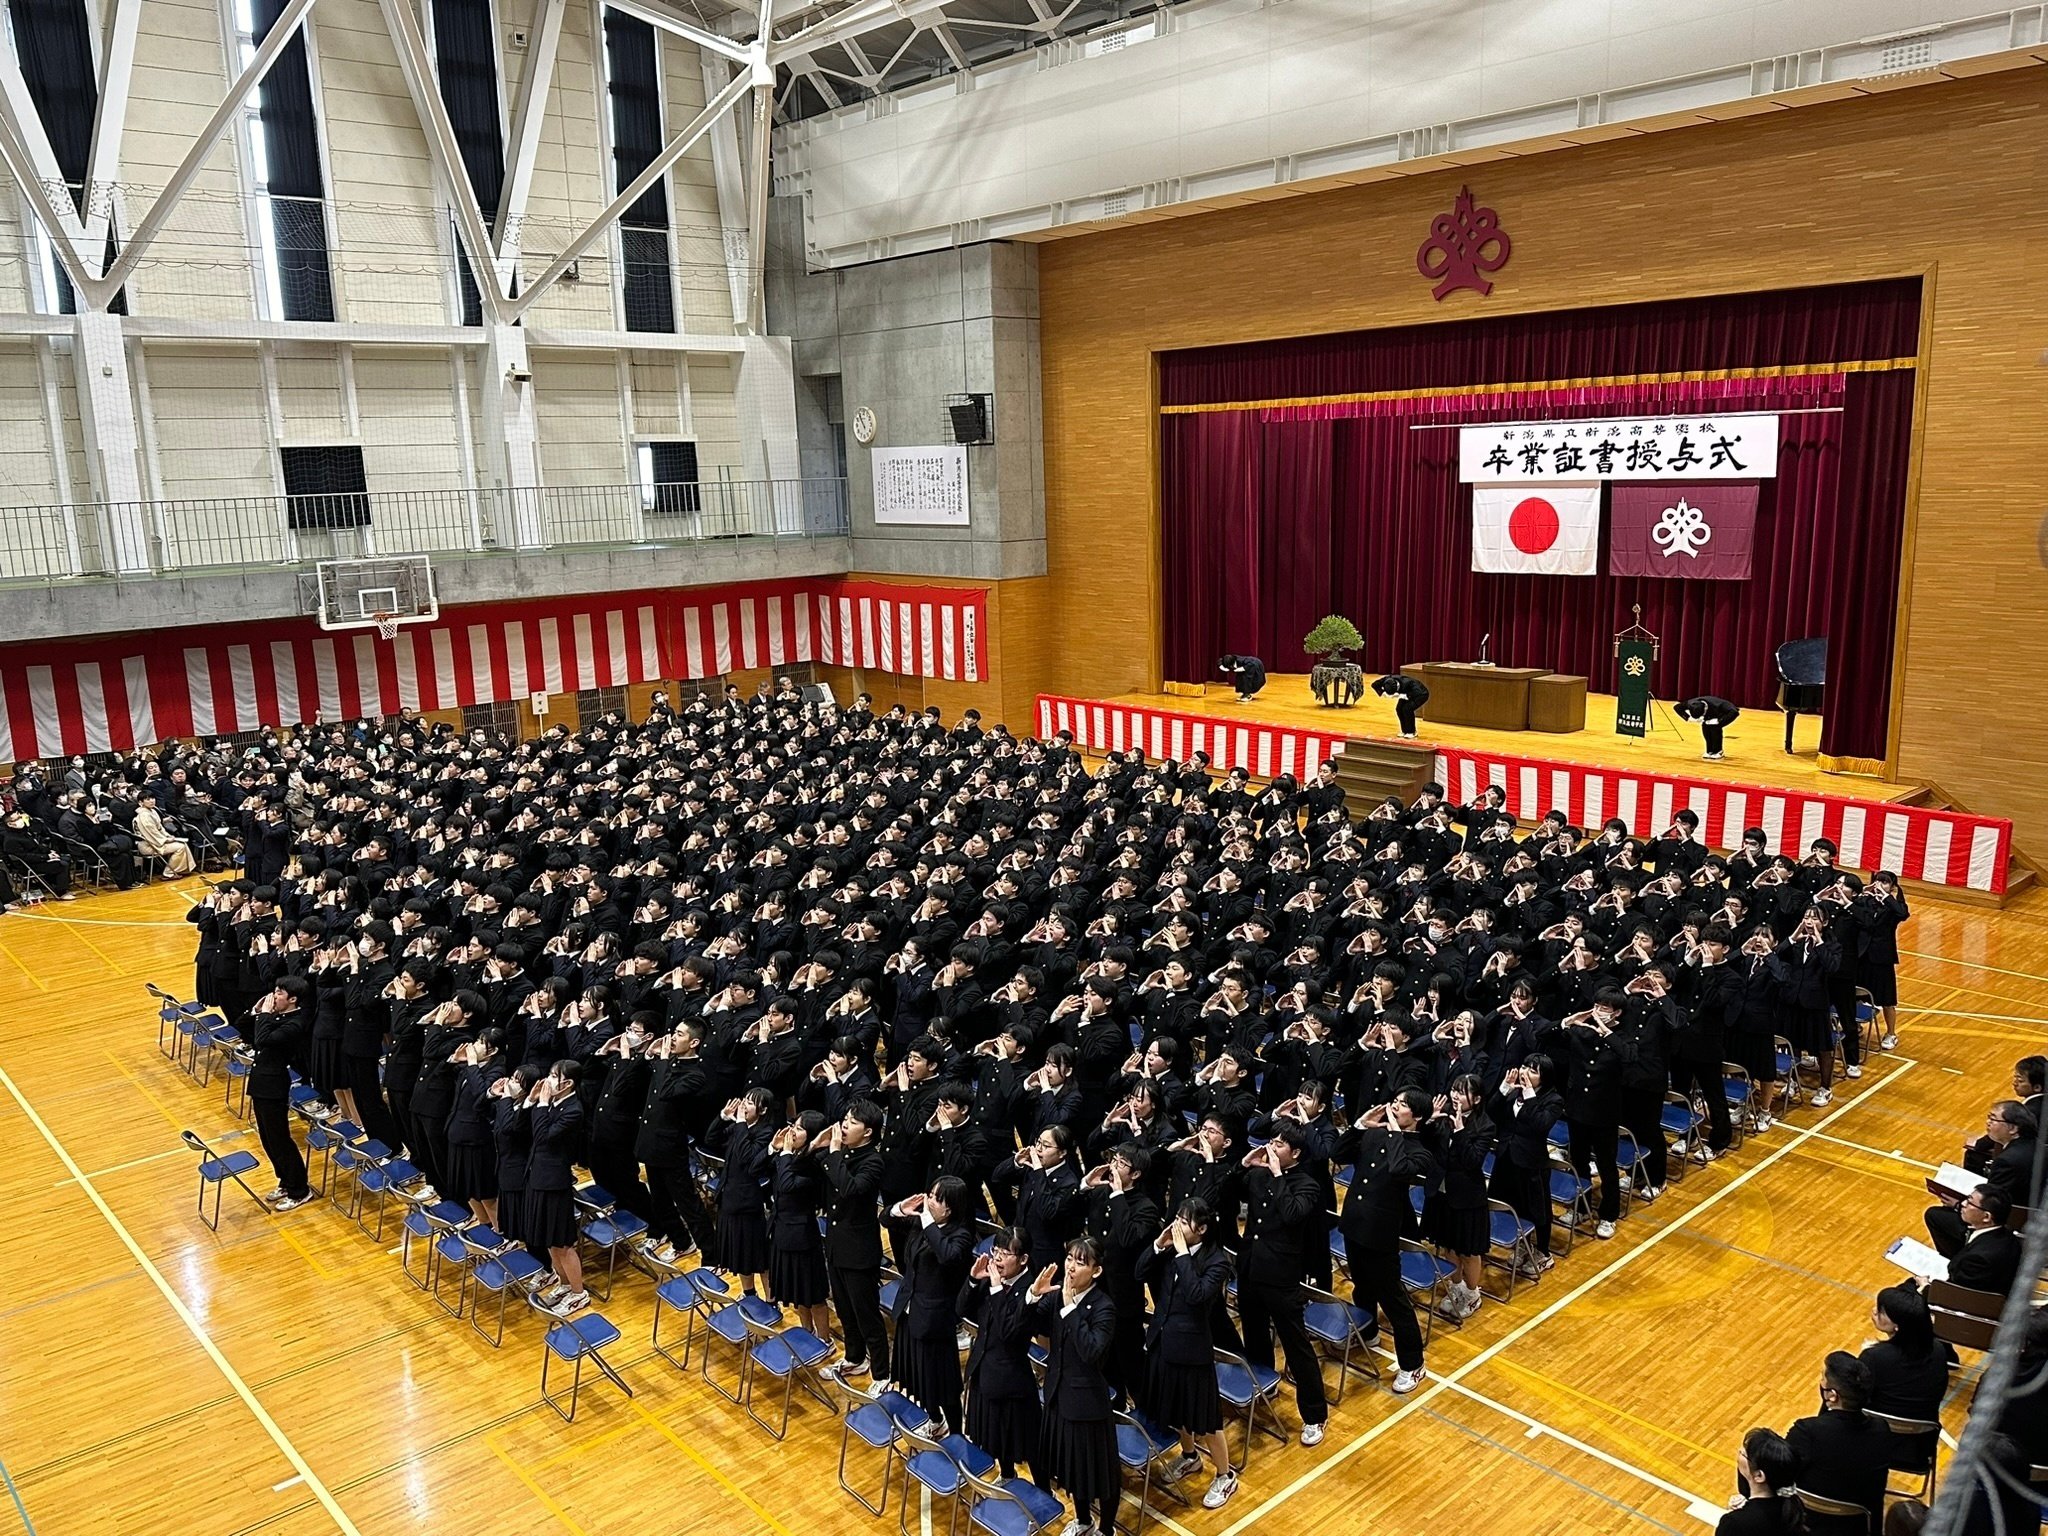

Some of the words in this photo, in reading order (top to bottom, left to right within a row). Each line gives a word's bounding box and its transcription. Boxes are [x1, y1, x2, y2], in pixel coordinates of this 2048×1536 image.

[1482, 436, 1748, 475] 卒業証書授与式
